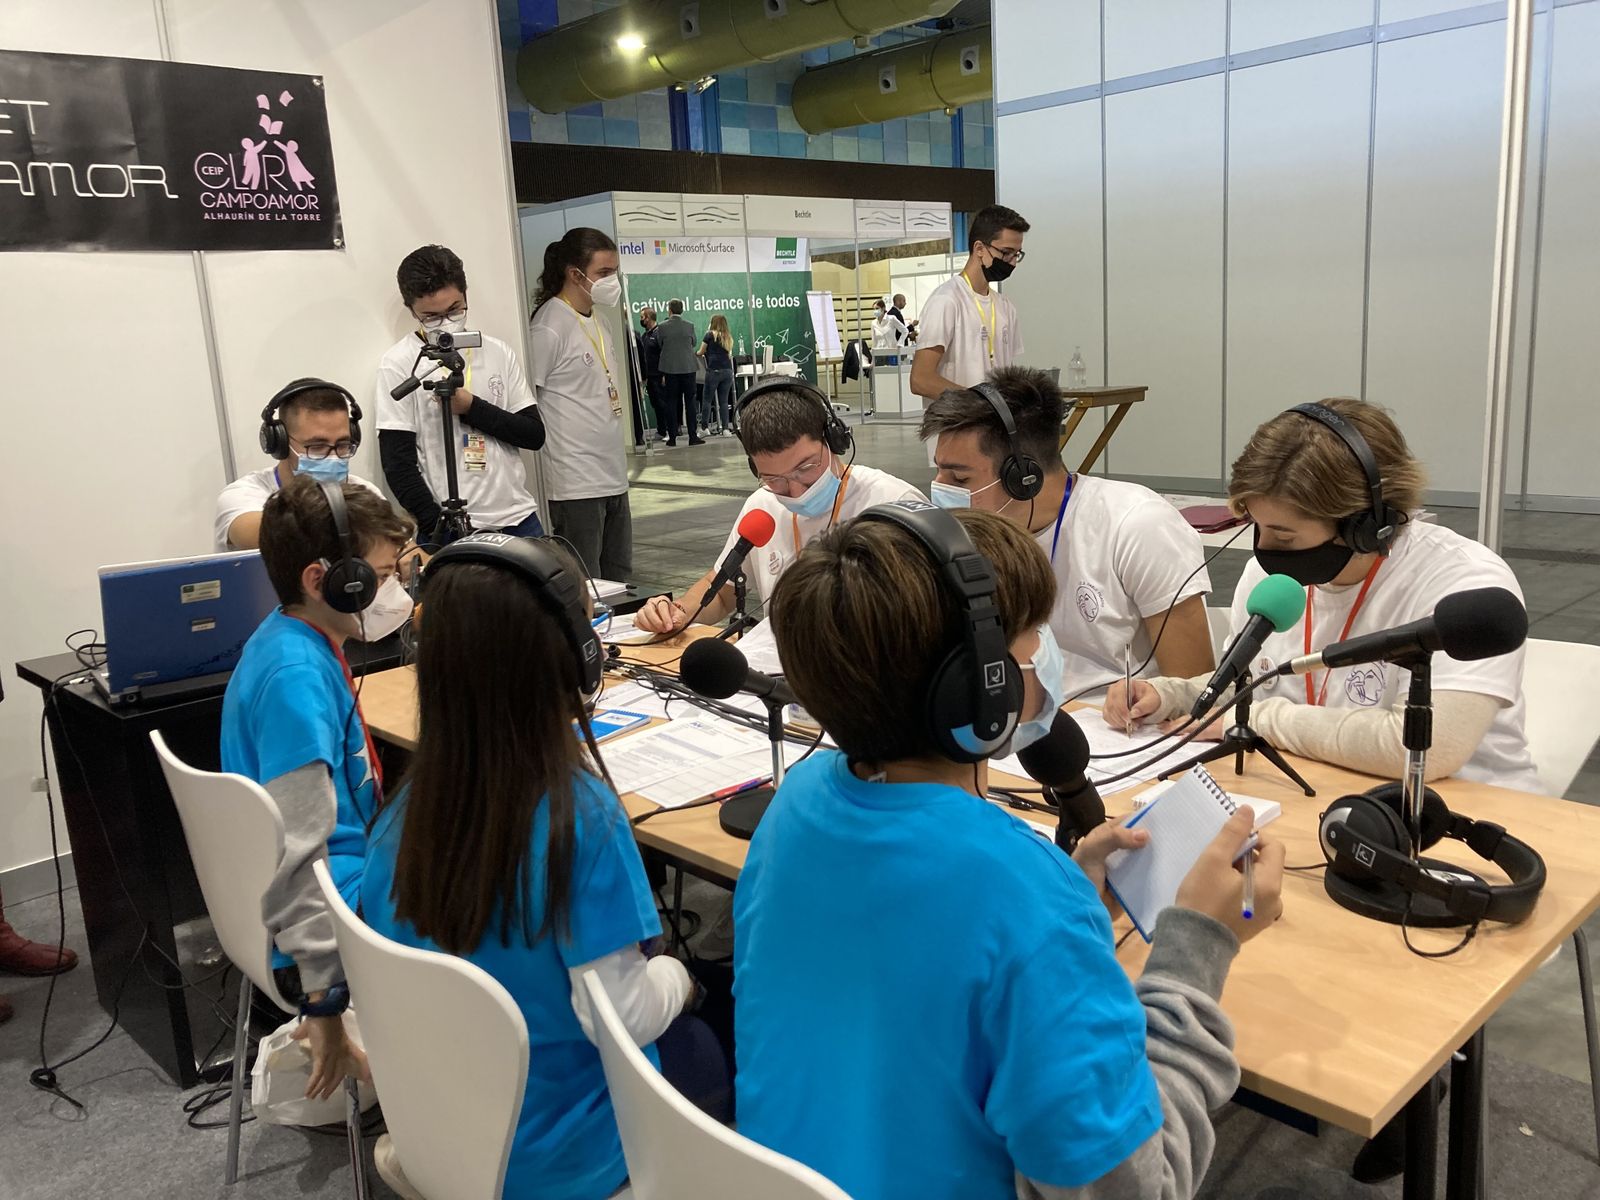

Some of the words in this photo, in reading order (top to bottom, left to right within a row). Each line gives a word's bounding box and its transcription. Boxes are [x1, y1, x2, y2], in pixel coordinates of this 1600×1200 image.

[201, 166, 224, 176] CEIP
[200, 192, 319, 210] CAMPOAMOR
[203, 211, 254, 220] ALHAURÍN
[259, 213, 270, 221] DE
[275, 213, 287, 221] LA
[291, 213, 321, 221] TORRE
[794, 210, 812, 219] Bechtle
[620, 242, 645, 255] intel
[668, 242, 706, 254] Microsoft
[707, 242, 735, 254] Surface
[694, 296, 743, 311] alcance
[747, 294, 763, 309] de
[766, 293, 800, 308] todos
